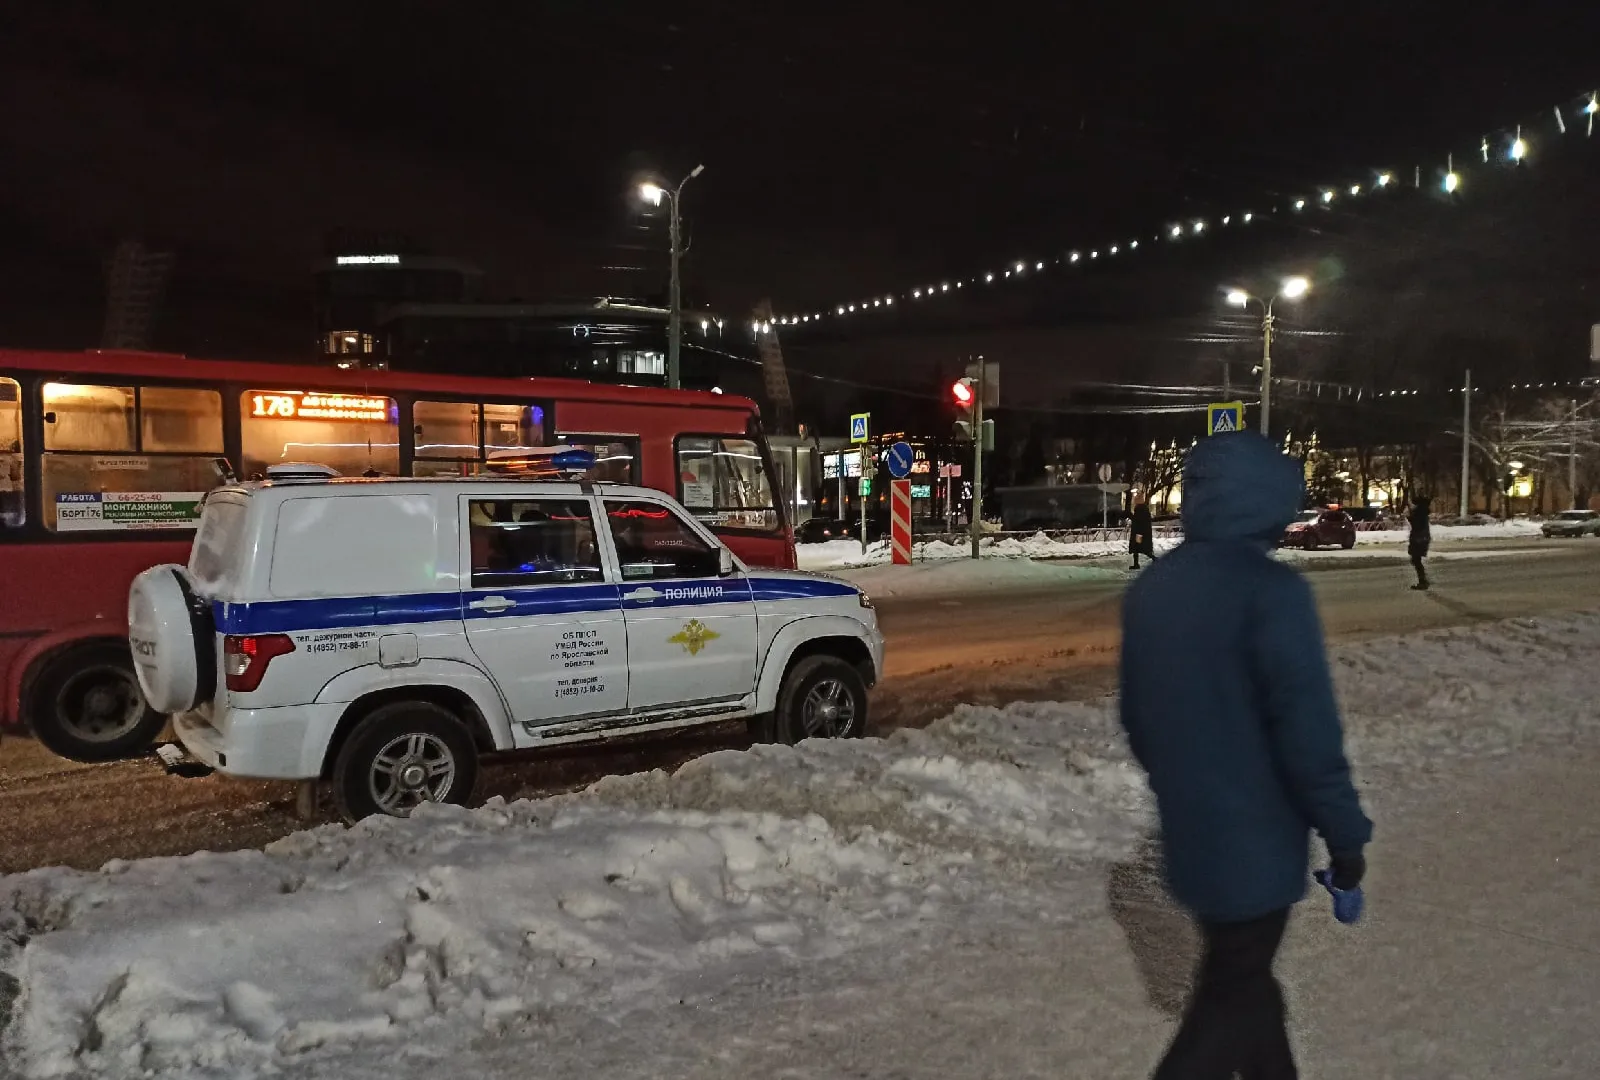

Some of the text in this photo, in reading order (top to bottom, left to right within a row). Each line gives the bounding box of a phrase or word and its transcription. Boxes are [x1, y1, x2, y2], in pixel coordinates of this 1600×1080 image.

[252, 395, 295, 417] 178
[61, 494, 96, 502] РАБОТА
[118, 493, 162, 502] 66-25-40
[104, 503, 173, 511] МОНТАЖНИКИ
[665, 586, 723, 600] ПОЛИЦИЯ
[313, 632, 353, 642] дежурной
[578, 640, 604, 648] России
[561, 648, 609, 660] Ярославской
[564, 660, 595, 668] области
